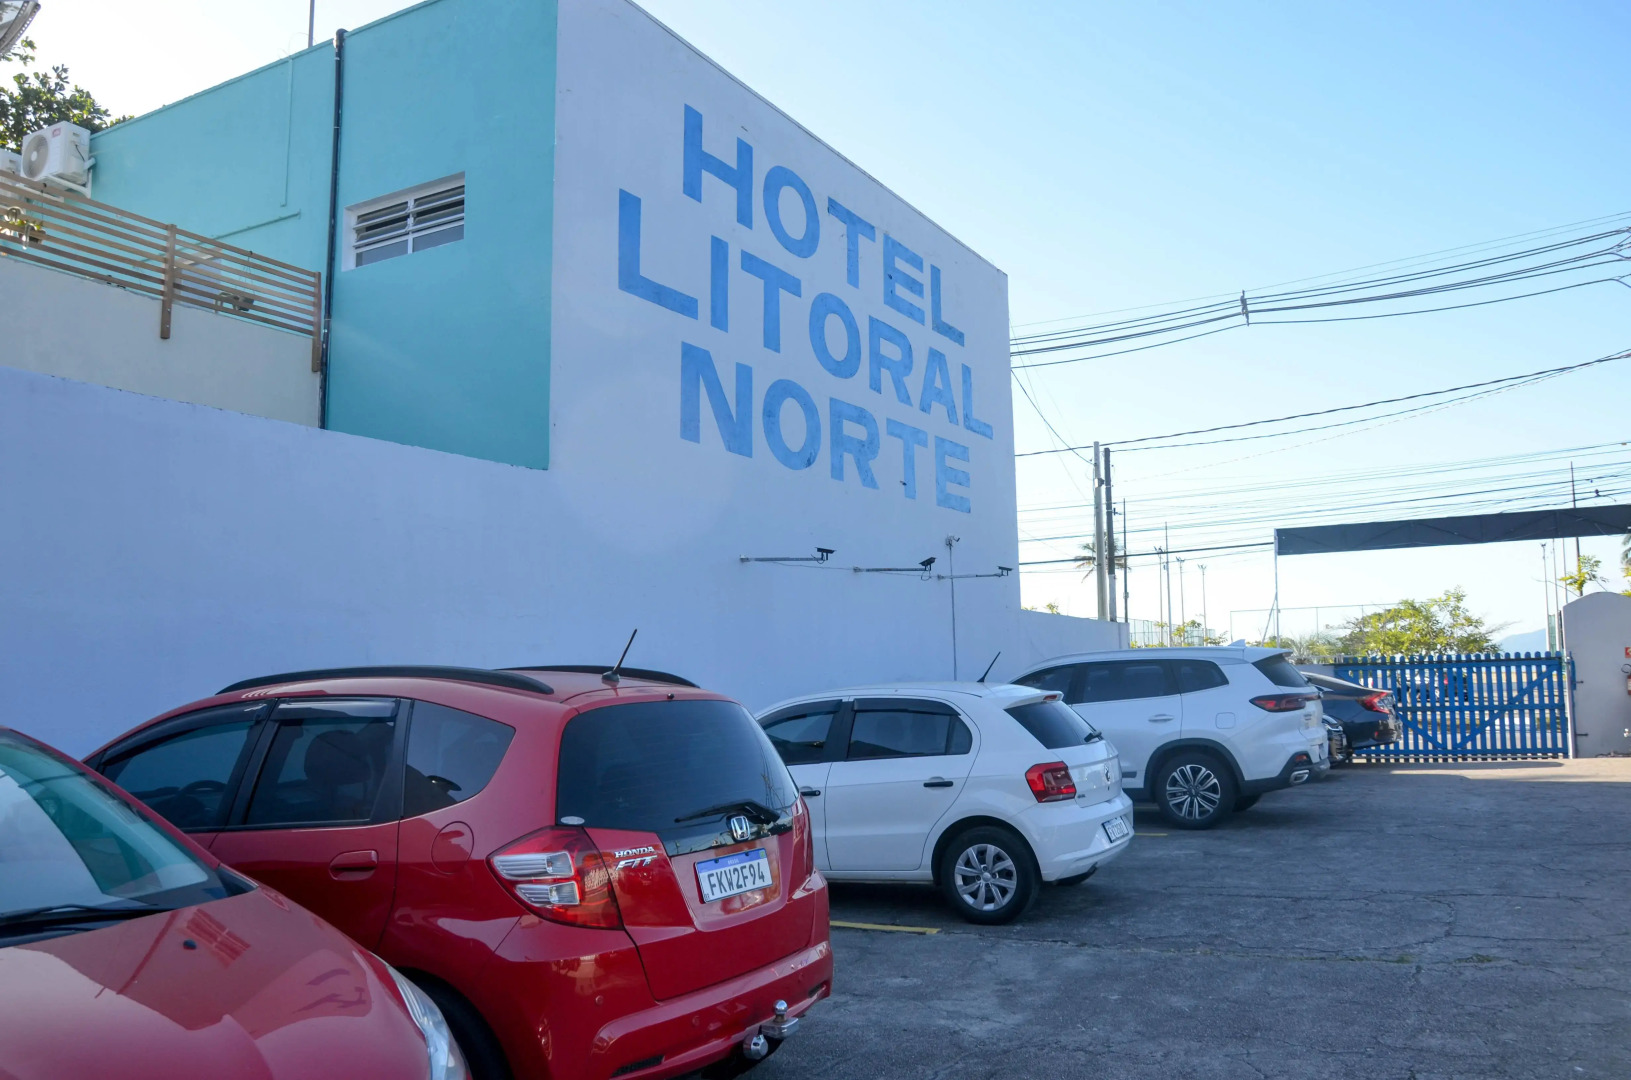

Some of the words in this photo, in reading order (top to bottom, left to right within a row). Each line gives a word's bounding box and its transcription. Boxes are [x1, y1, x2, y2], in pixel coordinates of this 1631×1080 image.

[683, 103, 964, 347] HOTEL
[618, 188, 993, 440] LITORAL
[680, 341, 971, 513] NORTE
[615, 846, 655, 858] HONDA
[616, 855, 658, 870] FIT
[707, 862, 765, 896] FKW2F94
